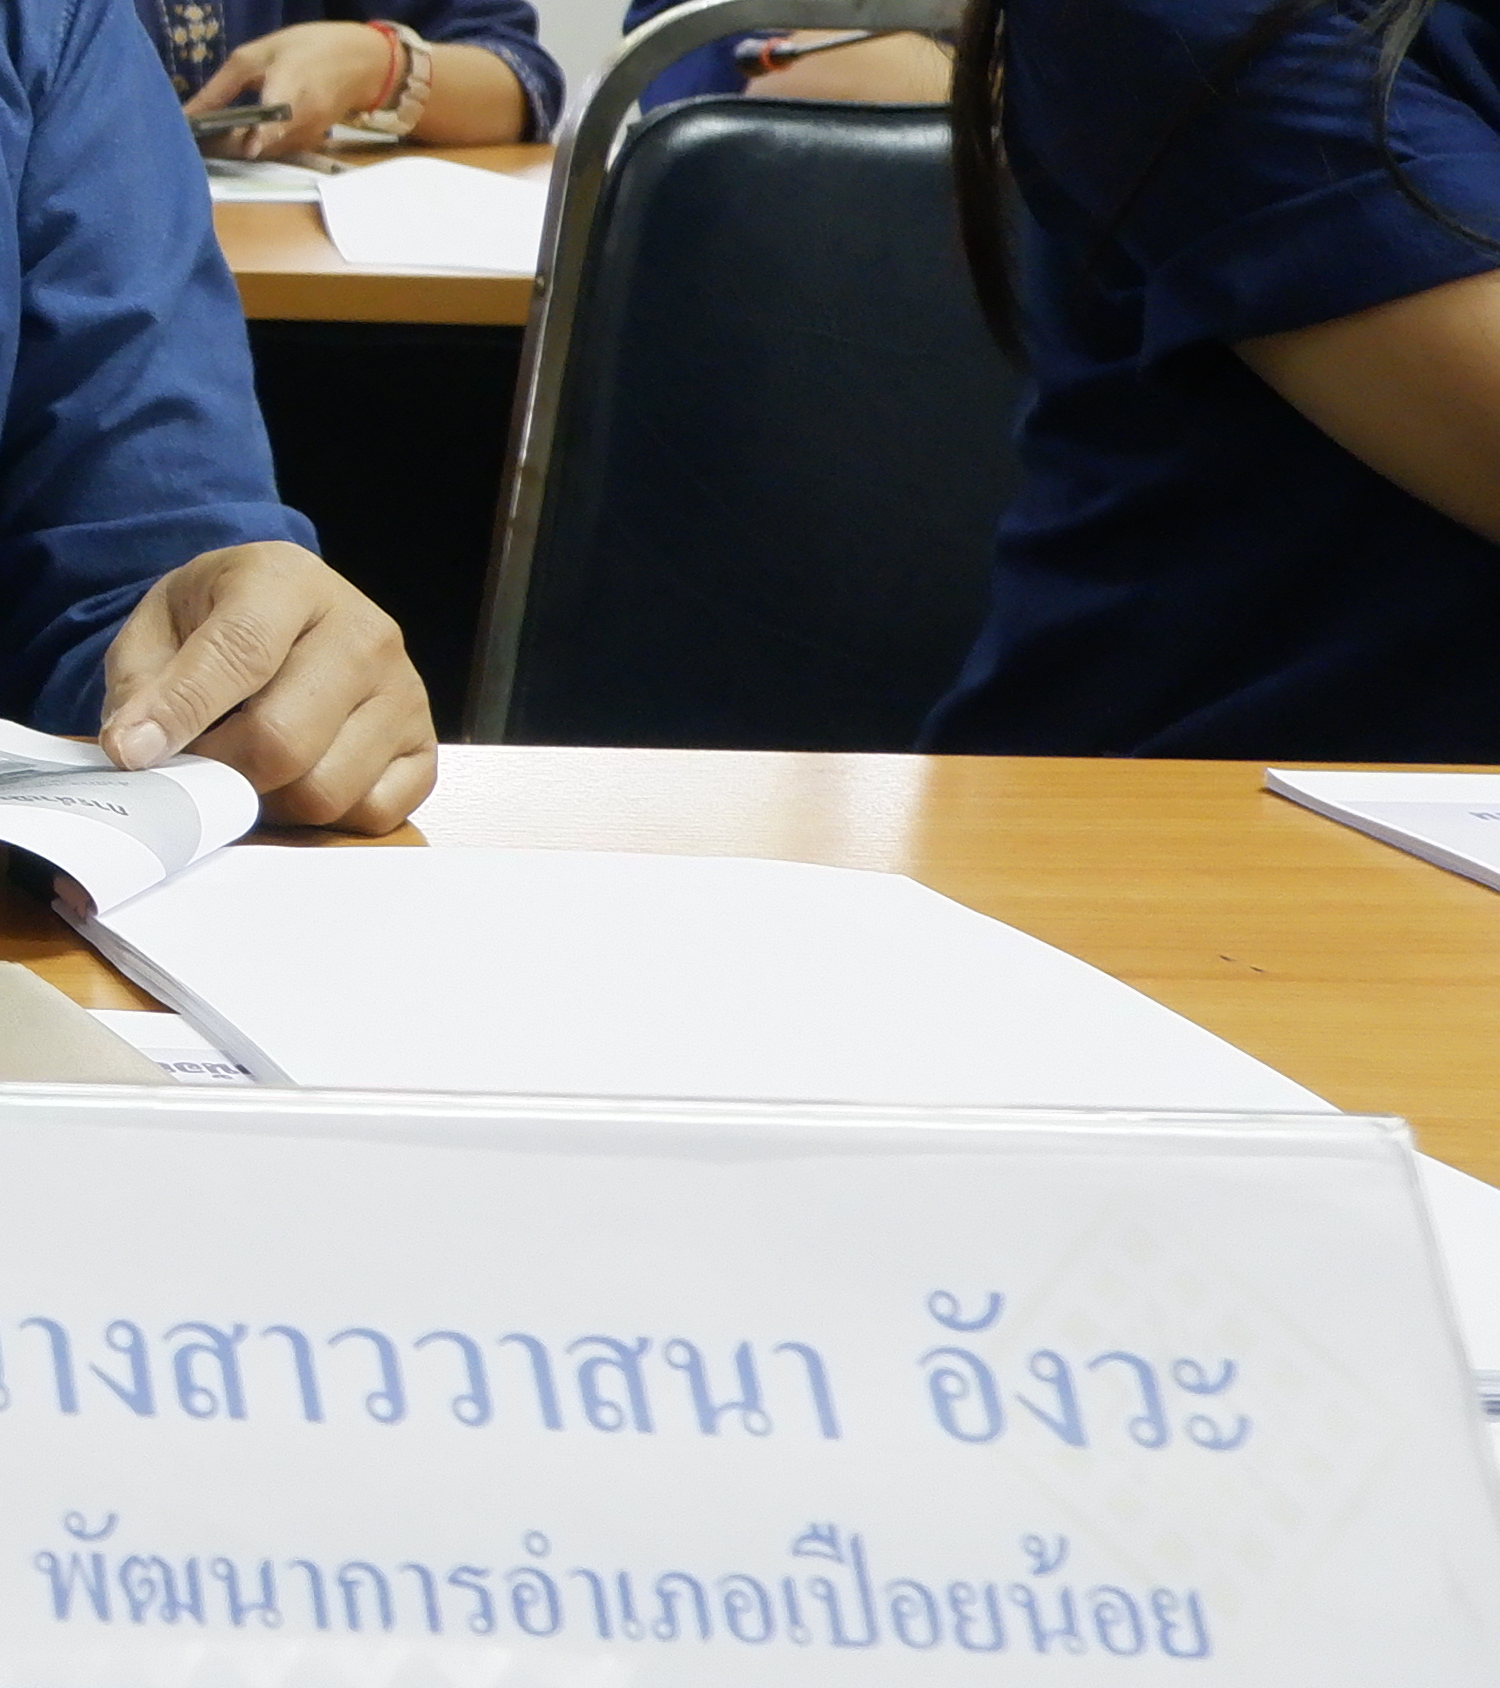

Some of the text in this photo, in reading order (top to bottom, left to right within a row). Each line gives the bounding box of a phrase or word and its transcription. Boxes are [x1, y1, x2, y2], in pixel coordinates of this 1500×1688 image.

[918, 1289, 1254, 1452] อังวะ
[34, 1511, 1213, 1662] พัฒนาการอำเภอเปือยน้อย
